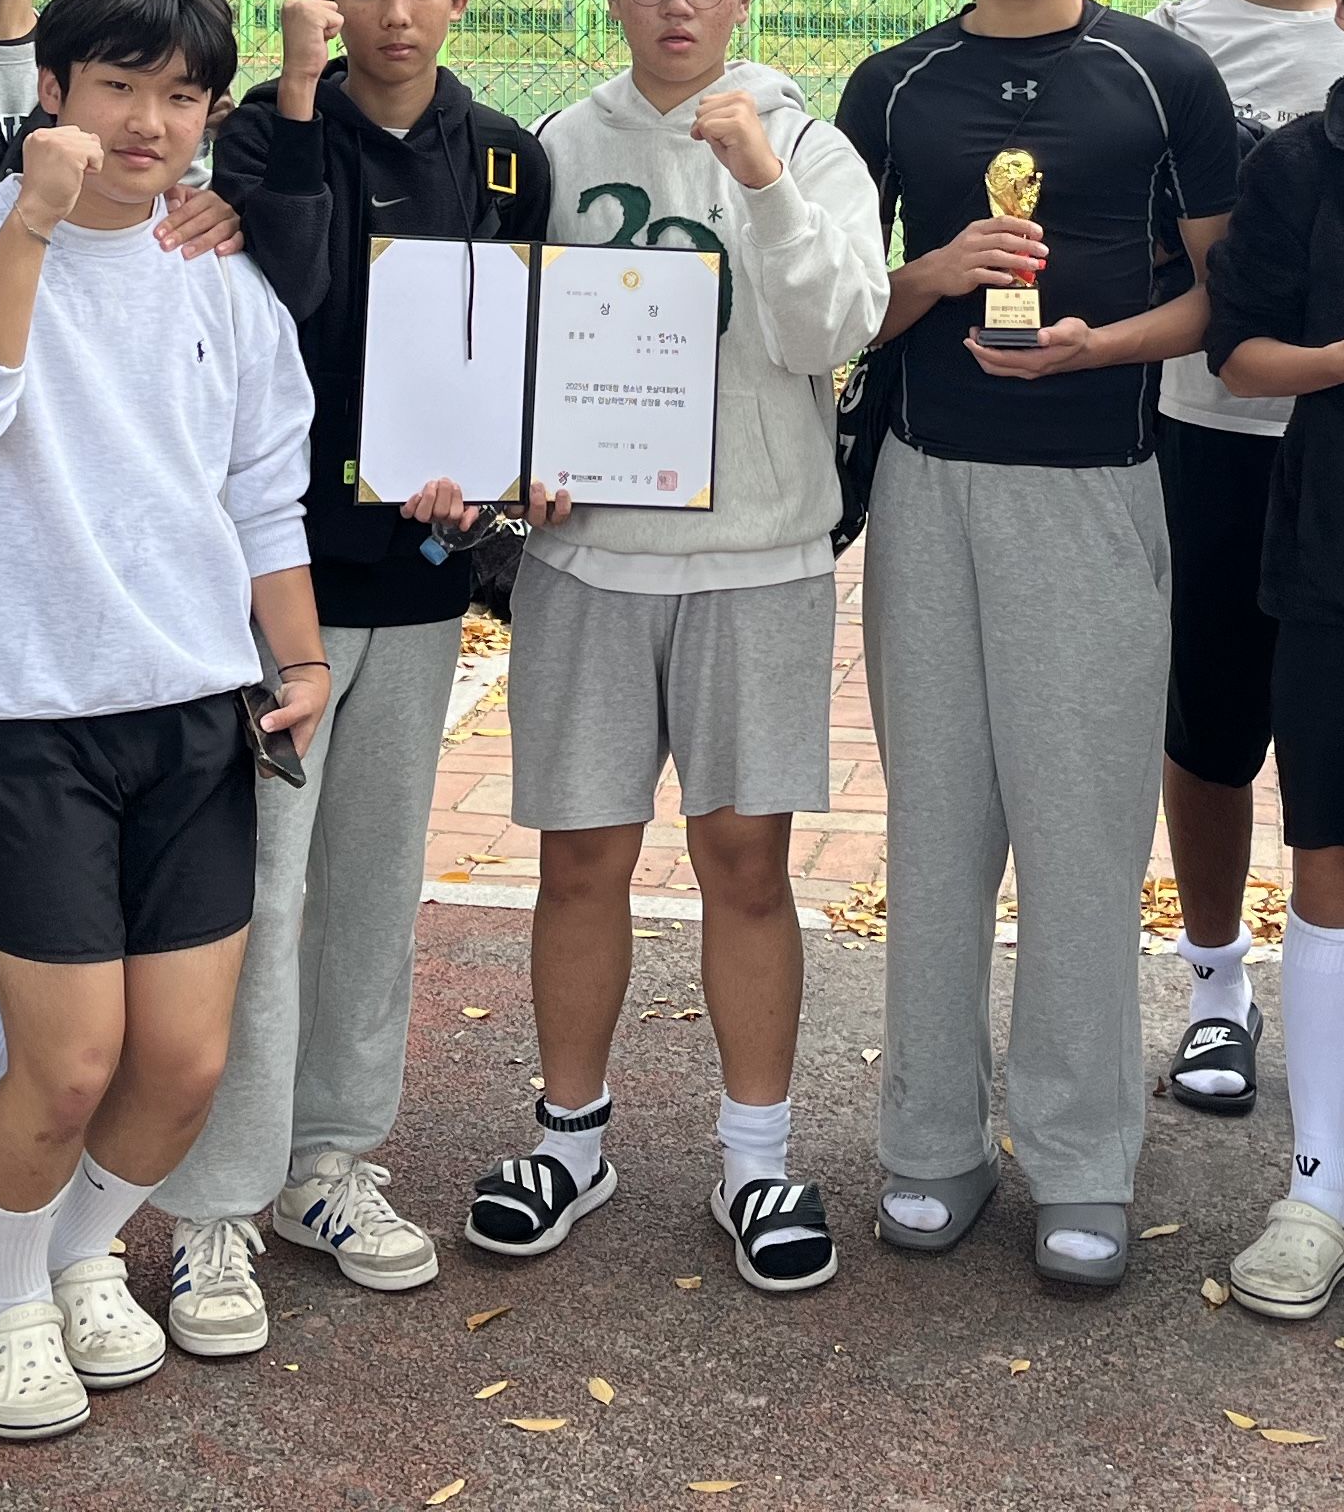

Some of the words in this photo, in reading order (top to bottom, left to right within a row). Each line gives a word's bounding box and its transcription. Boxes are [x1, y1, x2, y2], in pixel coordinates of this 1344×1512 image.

[599, 302, 611, 316] 상
[647, 304, 659, 318] 장
[565, 382, 589, 392] 2025년
[1192, 1026, 1231, 1045] NIKE
